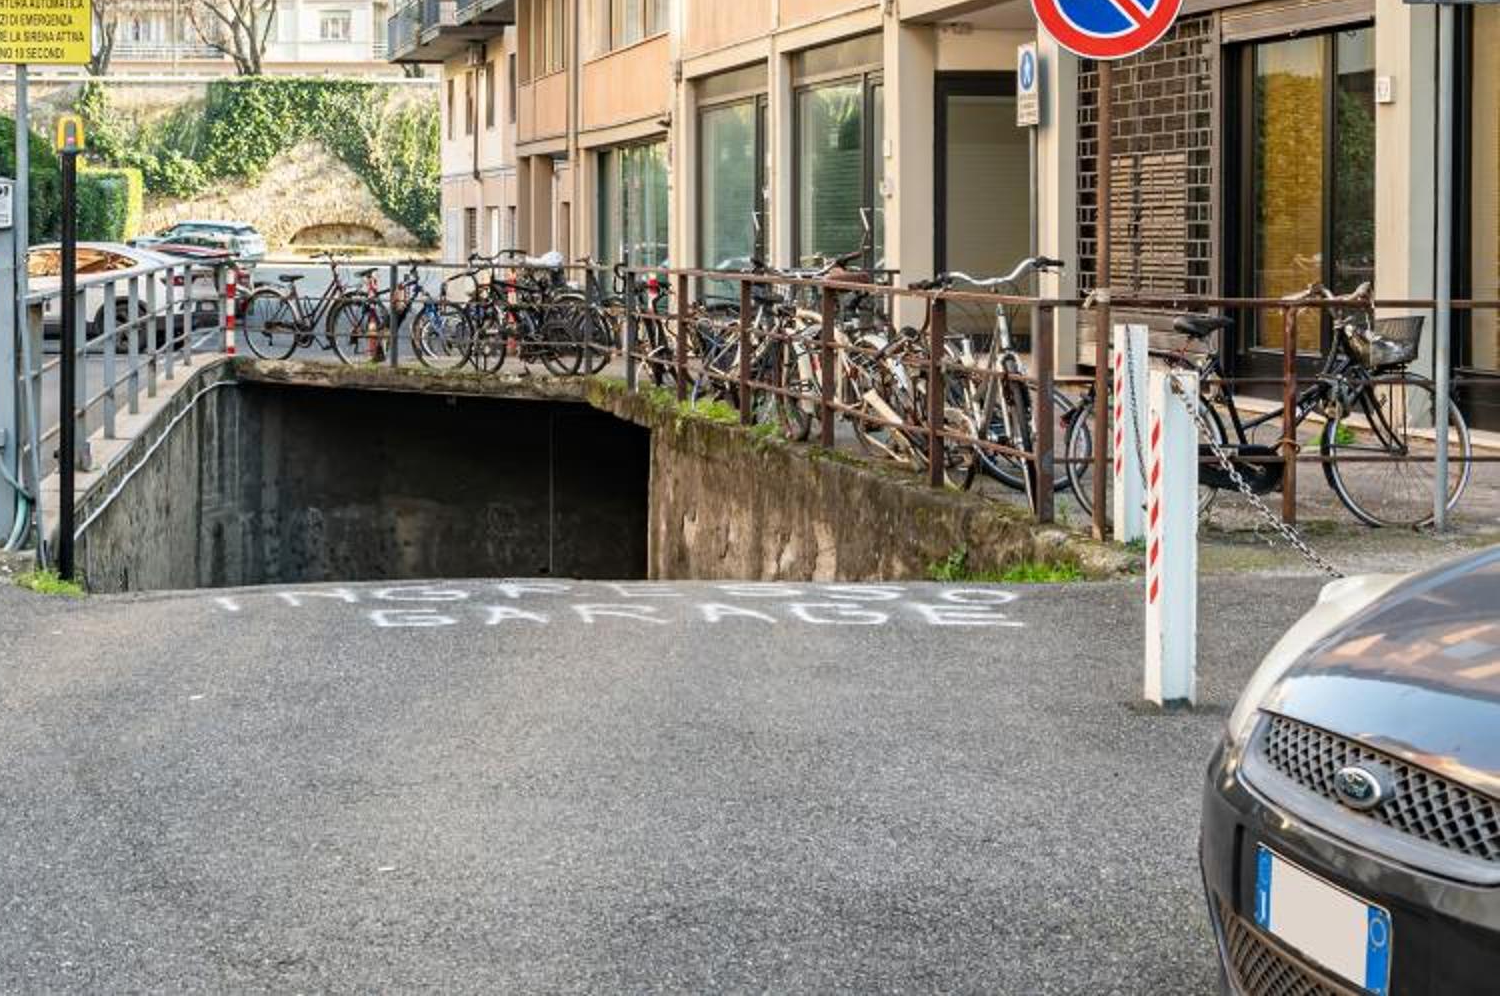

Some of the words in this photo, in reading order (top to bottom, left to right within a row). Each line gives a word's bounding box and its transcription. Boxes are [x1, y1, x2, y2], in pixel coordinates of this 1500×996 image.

[10, 14, 19, 26] DI
[20, 14, 73, 26] EMERGENZA
[9, 30, 21, 42] LA
[23, 30, 53, 42] SIRENA
[54, 30, 85, 42] ATTIVA
[26, 47, 65, 59] SECONDI
[368, 602, 1025, 628] GARAGE
